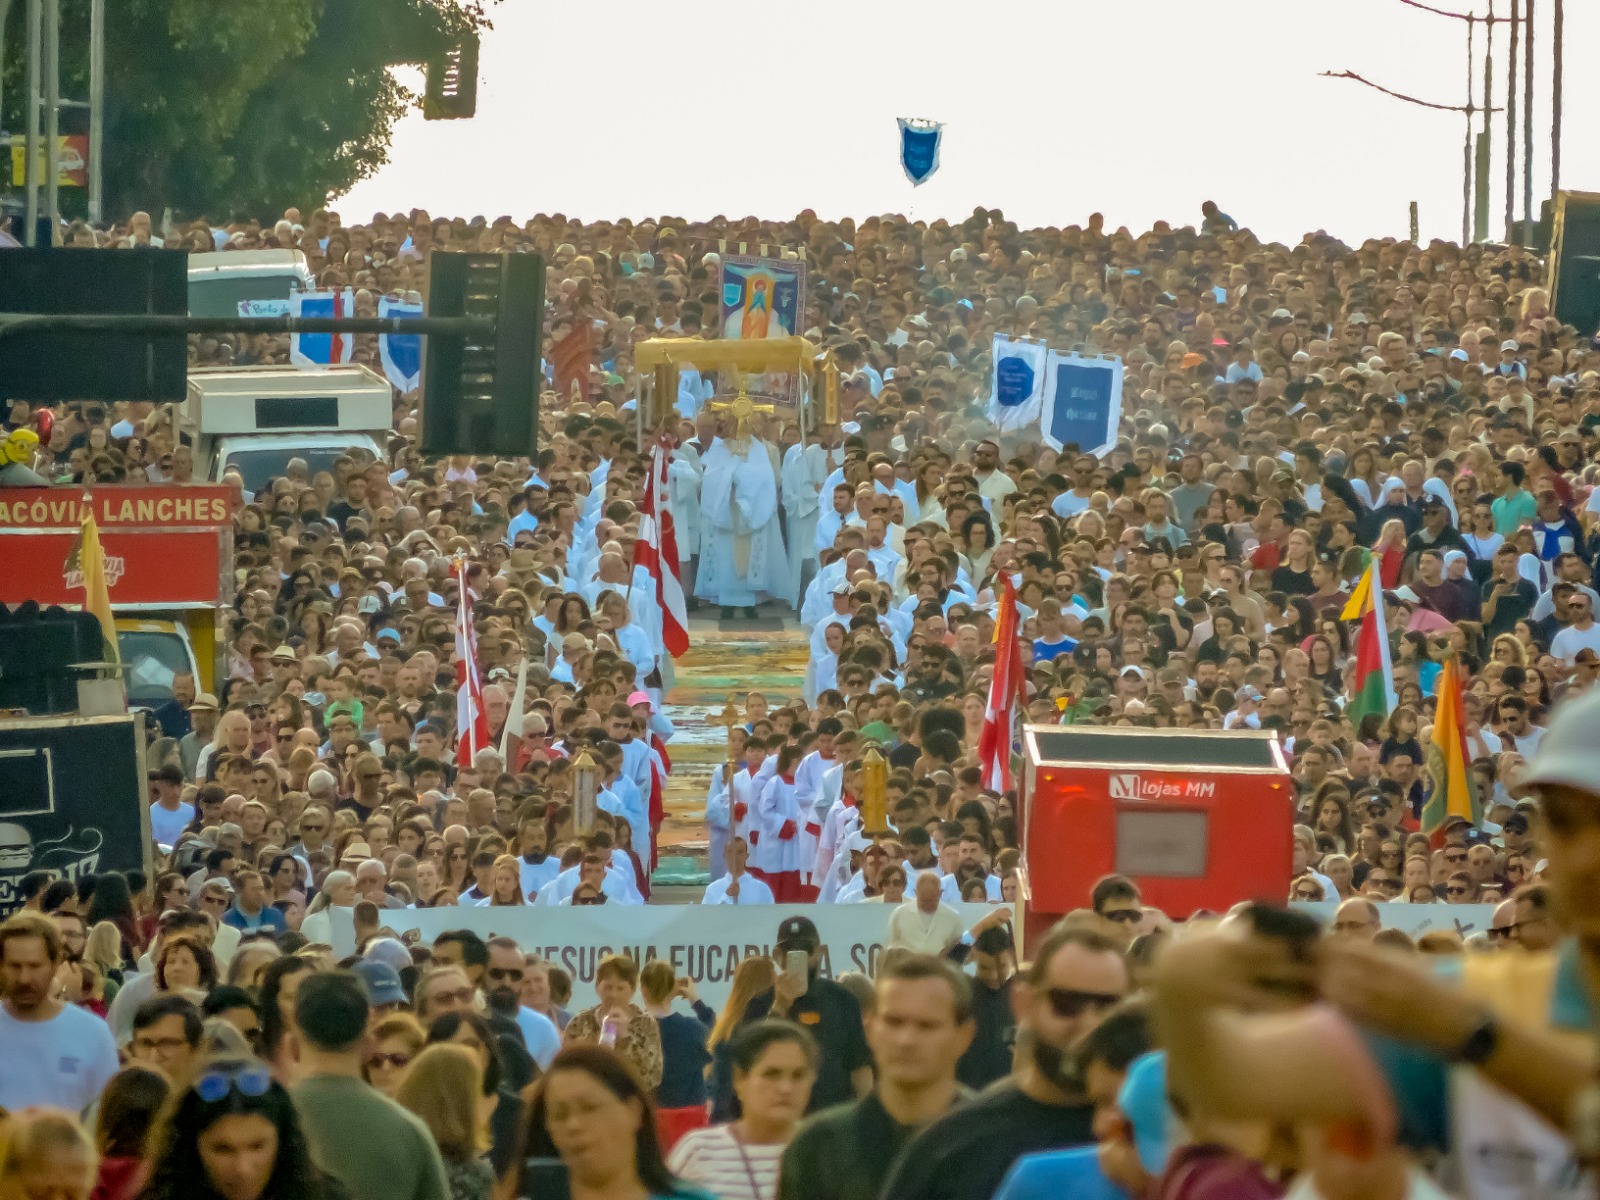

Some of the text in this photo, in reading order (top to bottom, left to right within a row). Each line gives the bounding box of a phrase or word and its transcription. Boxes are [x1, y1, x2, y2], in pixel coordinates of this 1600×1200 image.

[103, 498, 226, 522] LANCHES
[1142, 780, 1181, 798] lojas
[1185, 781, 1215, 798] MM
